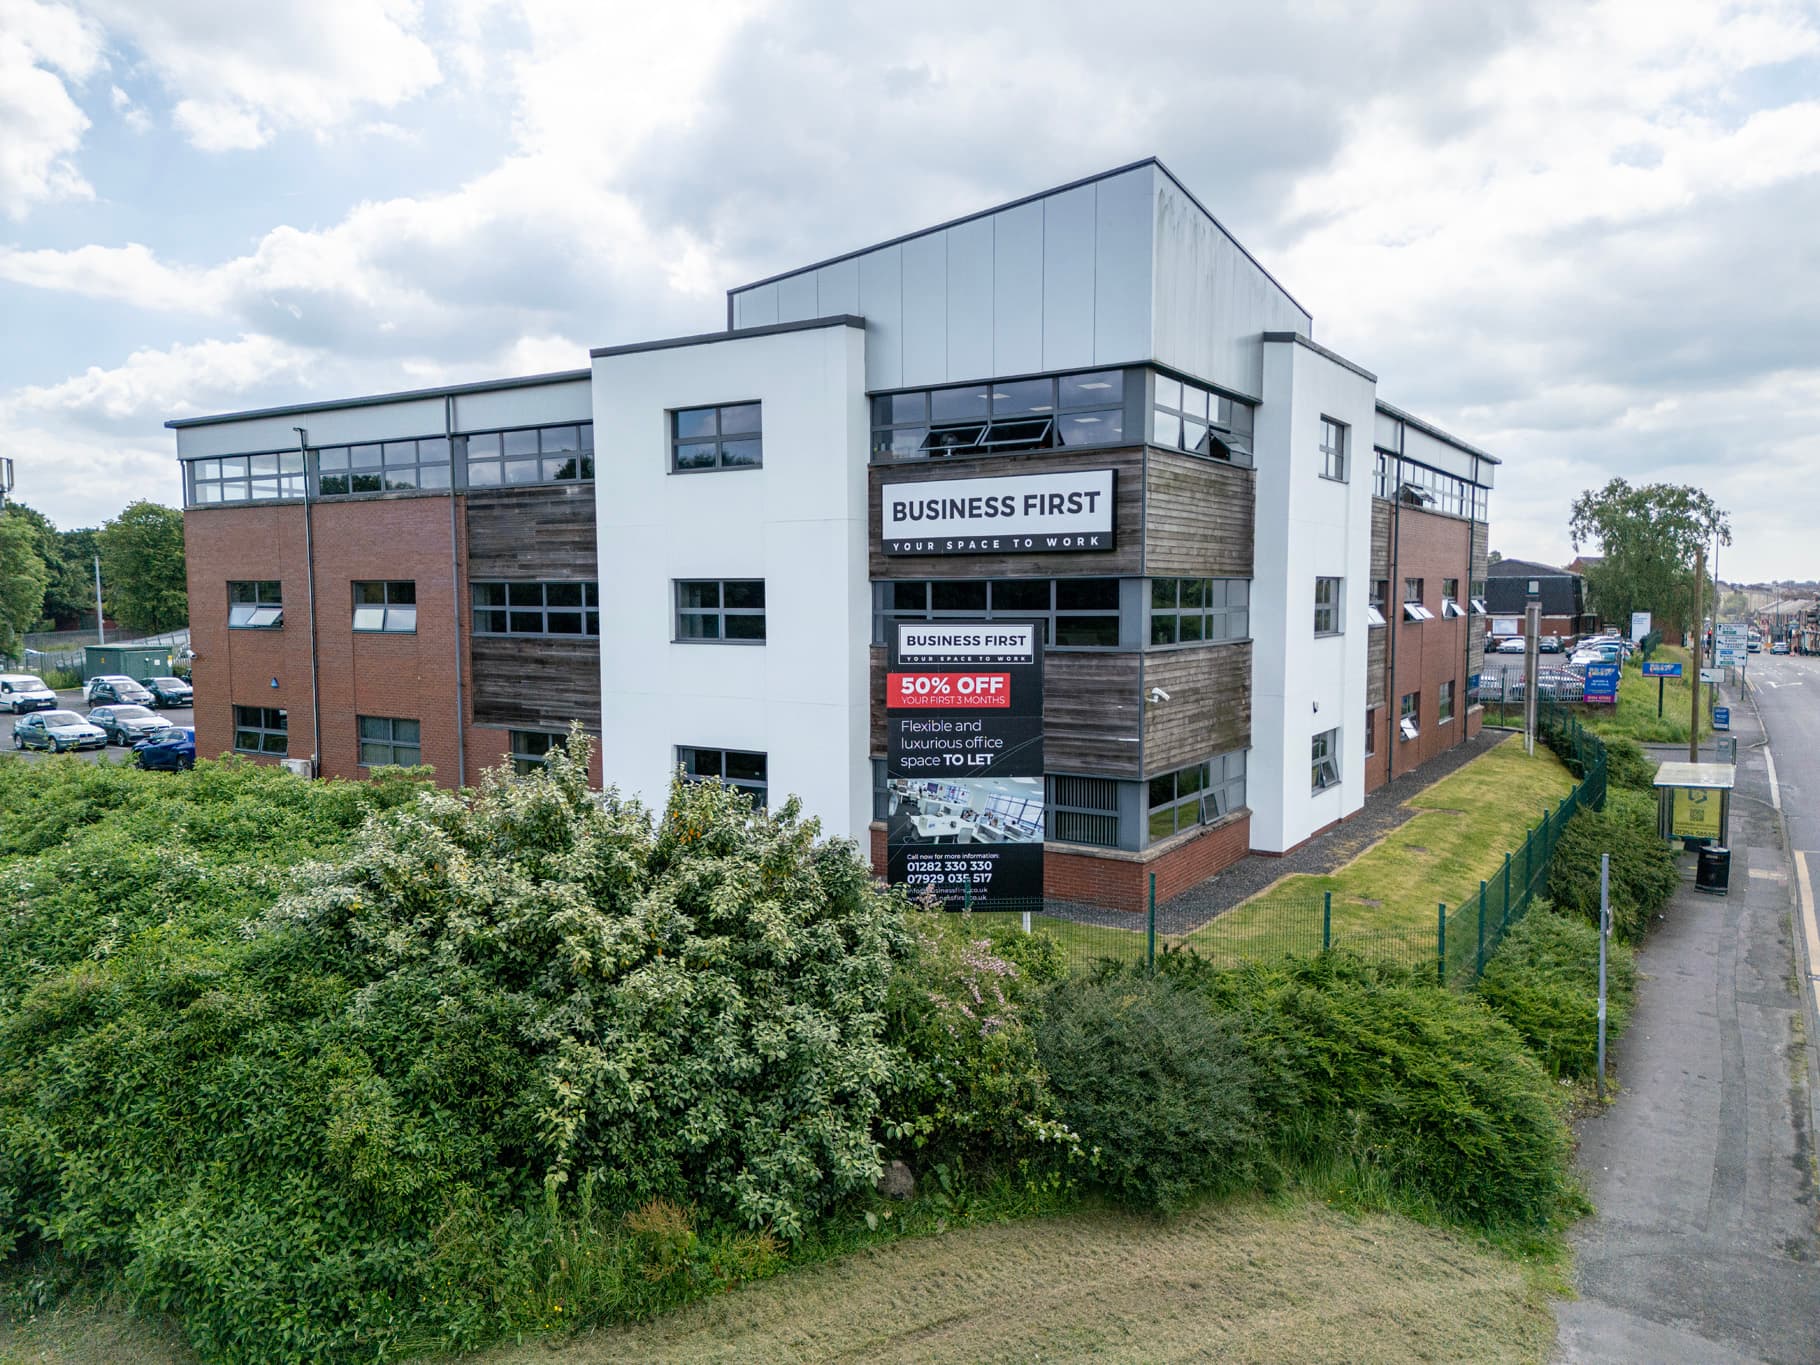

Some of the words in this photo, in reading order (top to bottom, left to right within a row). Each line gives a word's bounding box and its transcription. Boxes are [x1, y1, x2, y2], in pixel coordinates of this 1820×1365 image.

[893, 496, 1015, 522] BUSINESS
[1023, 491, 1101, 516] FIRST
[893, 542, 935, 552] YOUR
[946, 540, 1000, 550] SPACE
[1013, 539, 1033, 548] TO
[1046, 536, 1100, 547] WORK
[907, 635, 981, 646] BUSINESS
[985, 635, 1027, 646] FIRST
[901, 676, 951, 695] 50%
[957, 676, 1004, 695] OFF
[901, 696, 929, 705] YOUR
[930, 696, 955, 705] FIRST
[956, 696, 964, 705] 3
[963, 696, 1006, 705] MONTHS
[901, 720, 953, 732] Flexible
[955, 720, 982, 732] and
[901, 737, 963, 750] luxurious
[965, 736, 1004, 749] office
[900, 756, 941, 769] space
[943, 754, 964, 766] TO
[967, 754, 994, 766] LET
[907, 861, 942, 872] 01282
[944, 861, 967, 872] 330
[970, 861, 993, 871] 330
[907, 873, 945, 884] 07929
[973, 873, 993, 883] 517
